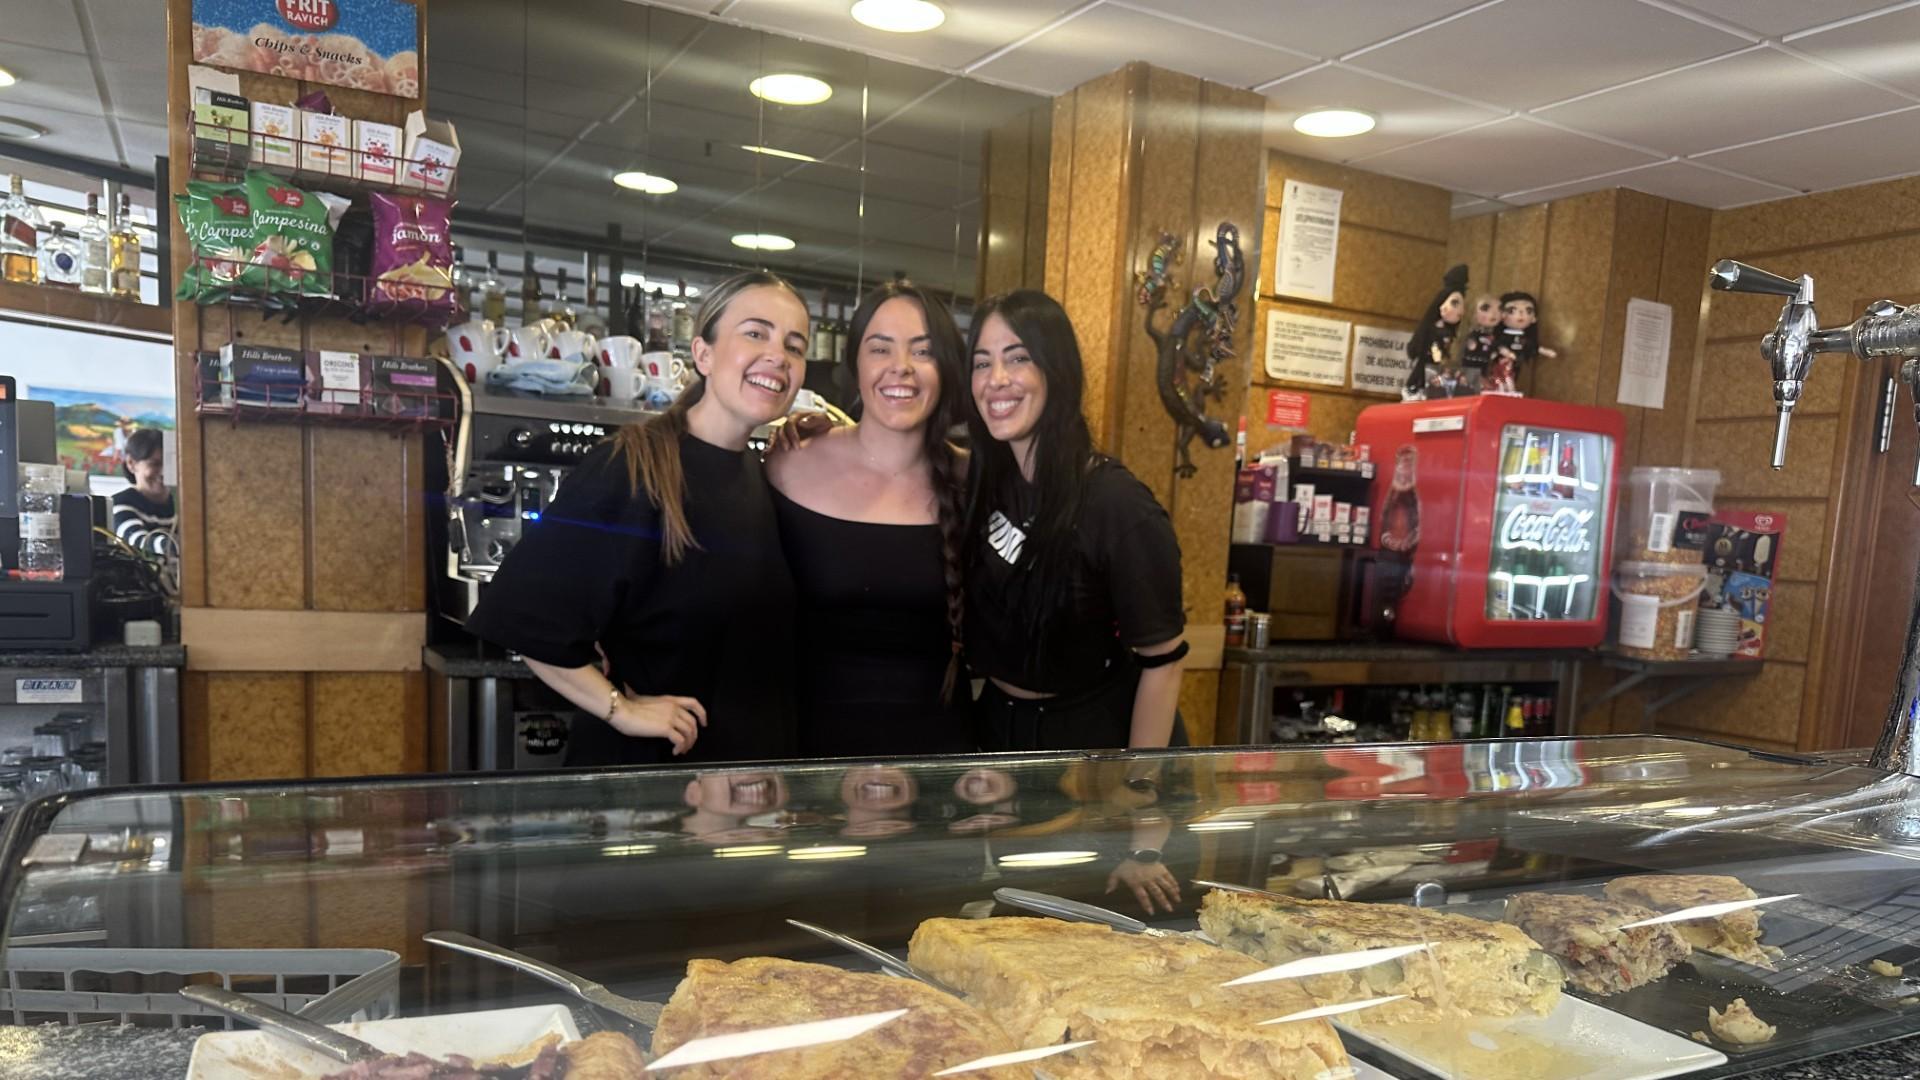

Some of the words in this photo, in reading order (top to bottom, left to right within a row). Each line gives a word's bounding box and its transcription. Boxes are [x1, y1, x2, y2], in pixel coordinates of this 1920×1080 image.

[286, 0, 330, 15] FRIT
[286, 11, 329, 26] RAVICH
[254, 37, 295, 54] Chips
[300, 43, 311, 55] &
[315, 47, 363, 65] Snacks
[252, 209, 328, 236] Campesina
[241, 350, 261, 360] Hills
